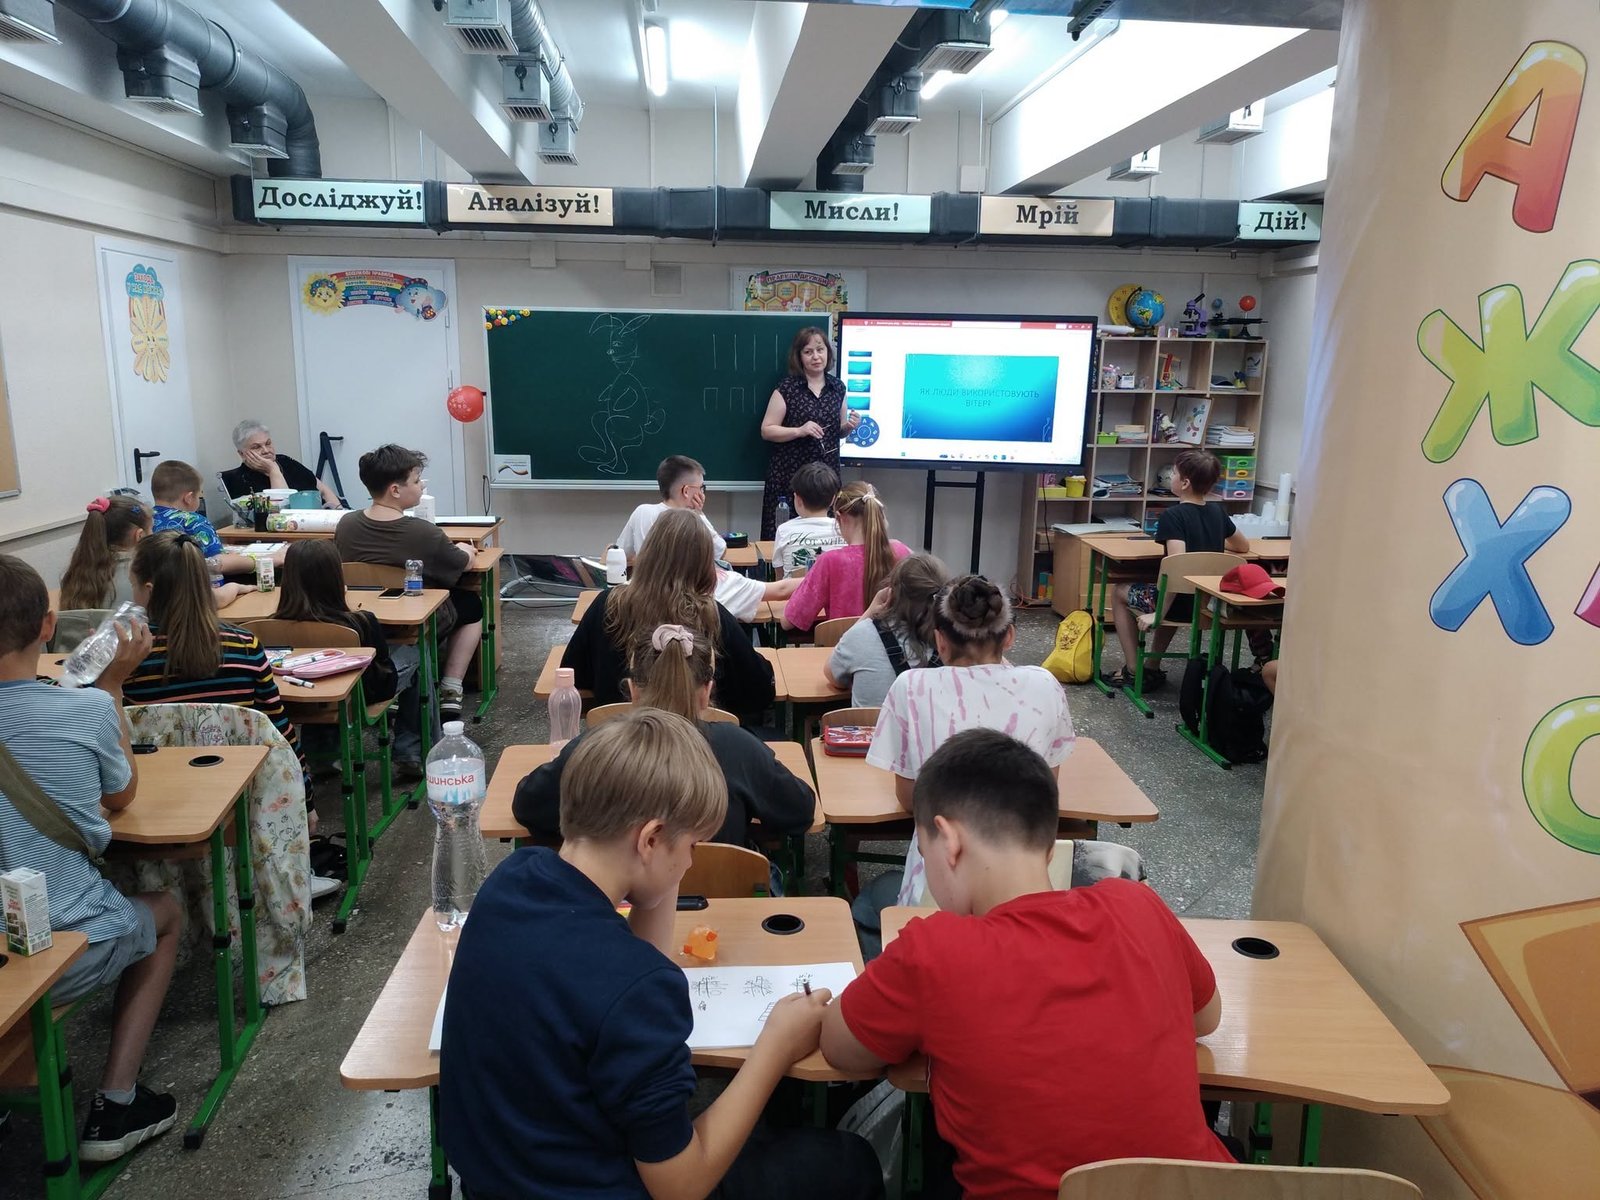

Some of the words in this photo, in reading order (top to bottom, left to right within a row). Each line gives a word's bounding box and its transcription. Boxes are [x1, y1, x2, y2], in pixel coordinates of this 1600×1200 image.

[1441, 40, 1588, 233] А
[258, 186, 422, 215] Досліджуй!
[468, 191, 599, 218] Аналізуй!
[804, 199, 899, 221] Мисли!
[1016, 204, 1079, 229] Мрій
[1253, 210, 1307, 233] Дій!
[767, 273, 799, 283] ПРАВИЛА
[1417, 258, 1600, 464] Ж
[919, 388, 930, 396] ЯК
[933, 388, 959, 397] ЛЮДИ
[961, 388, 1040, 398] ВИКОРИСТОВУЮТЬ
[1428, 477, 1572, 647] Х
